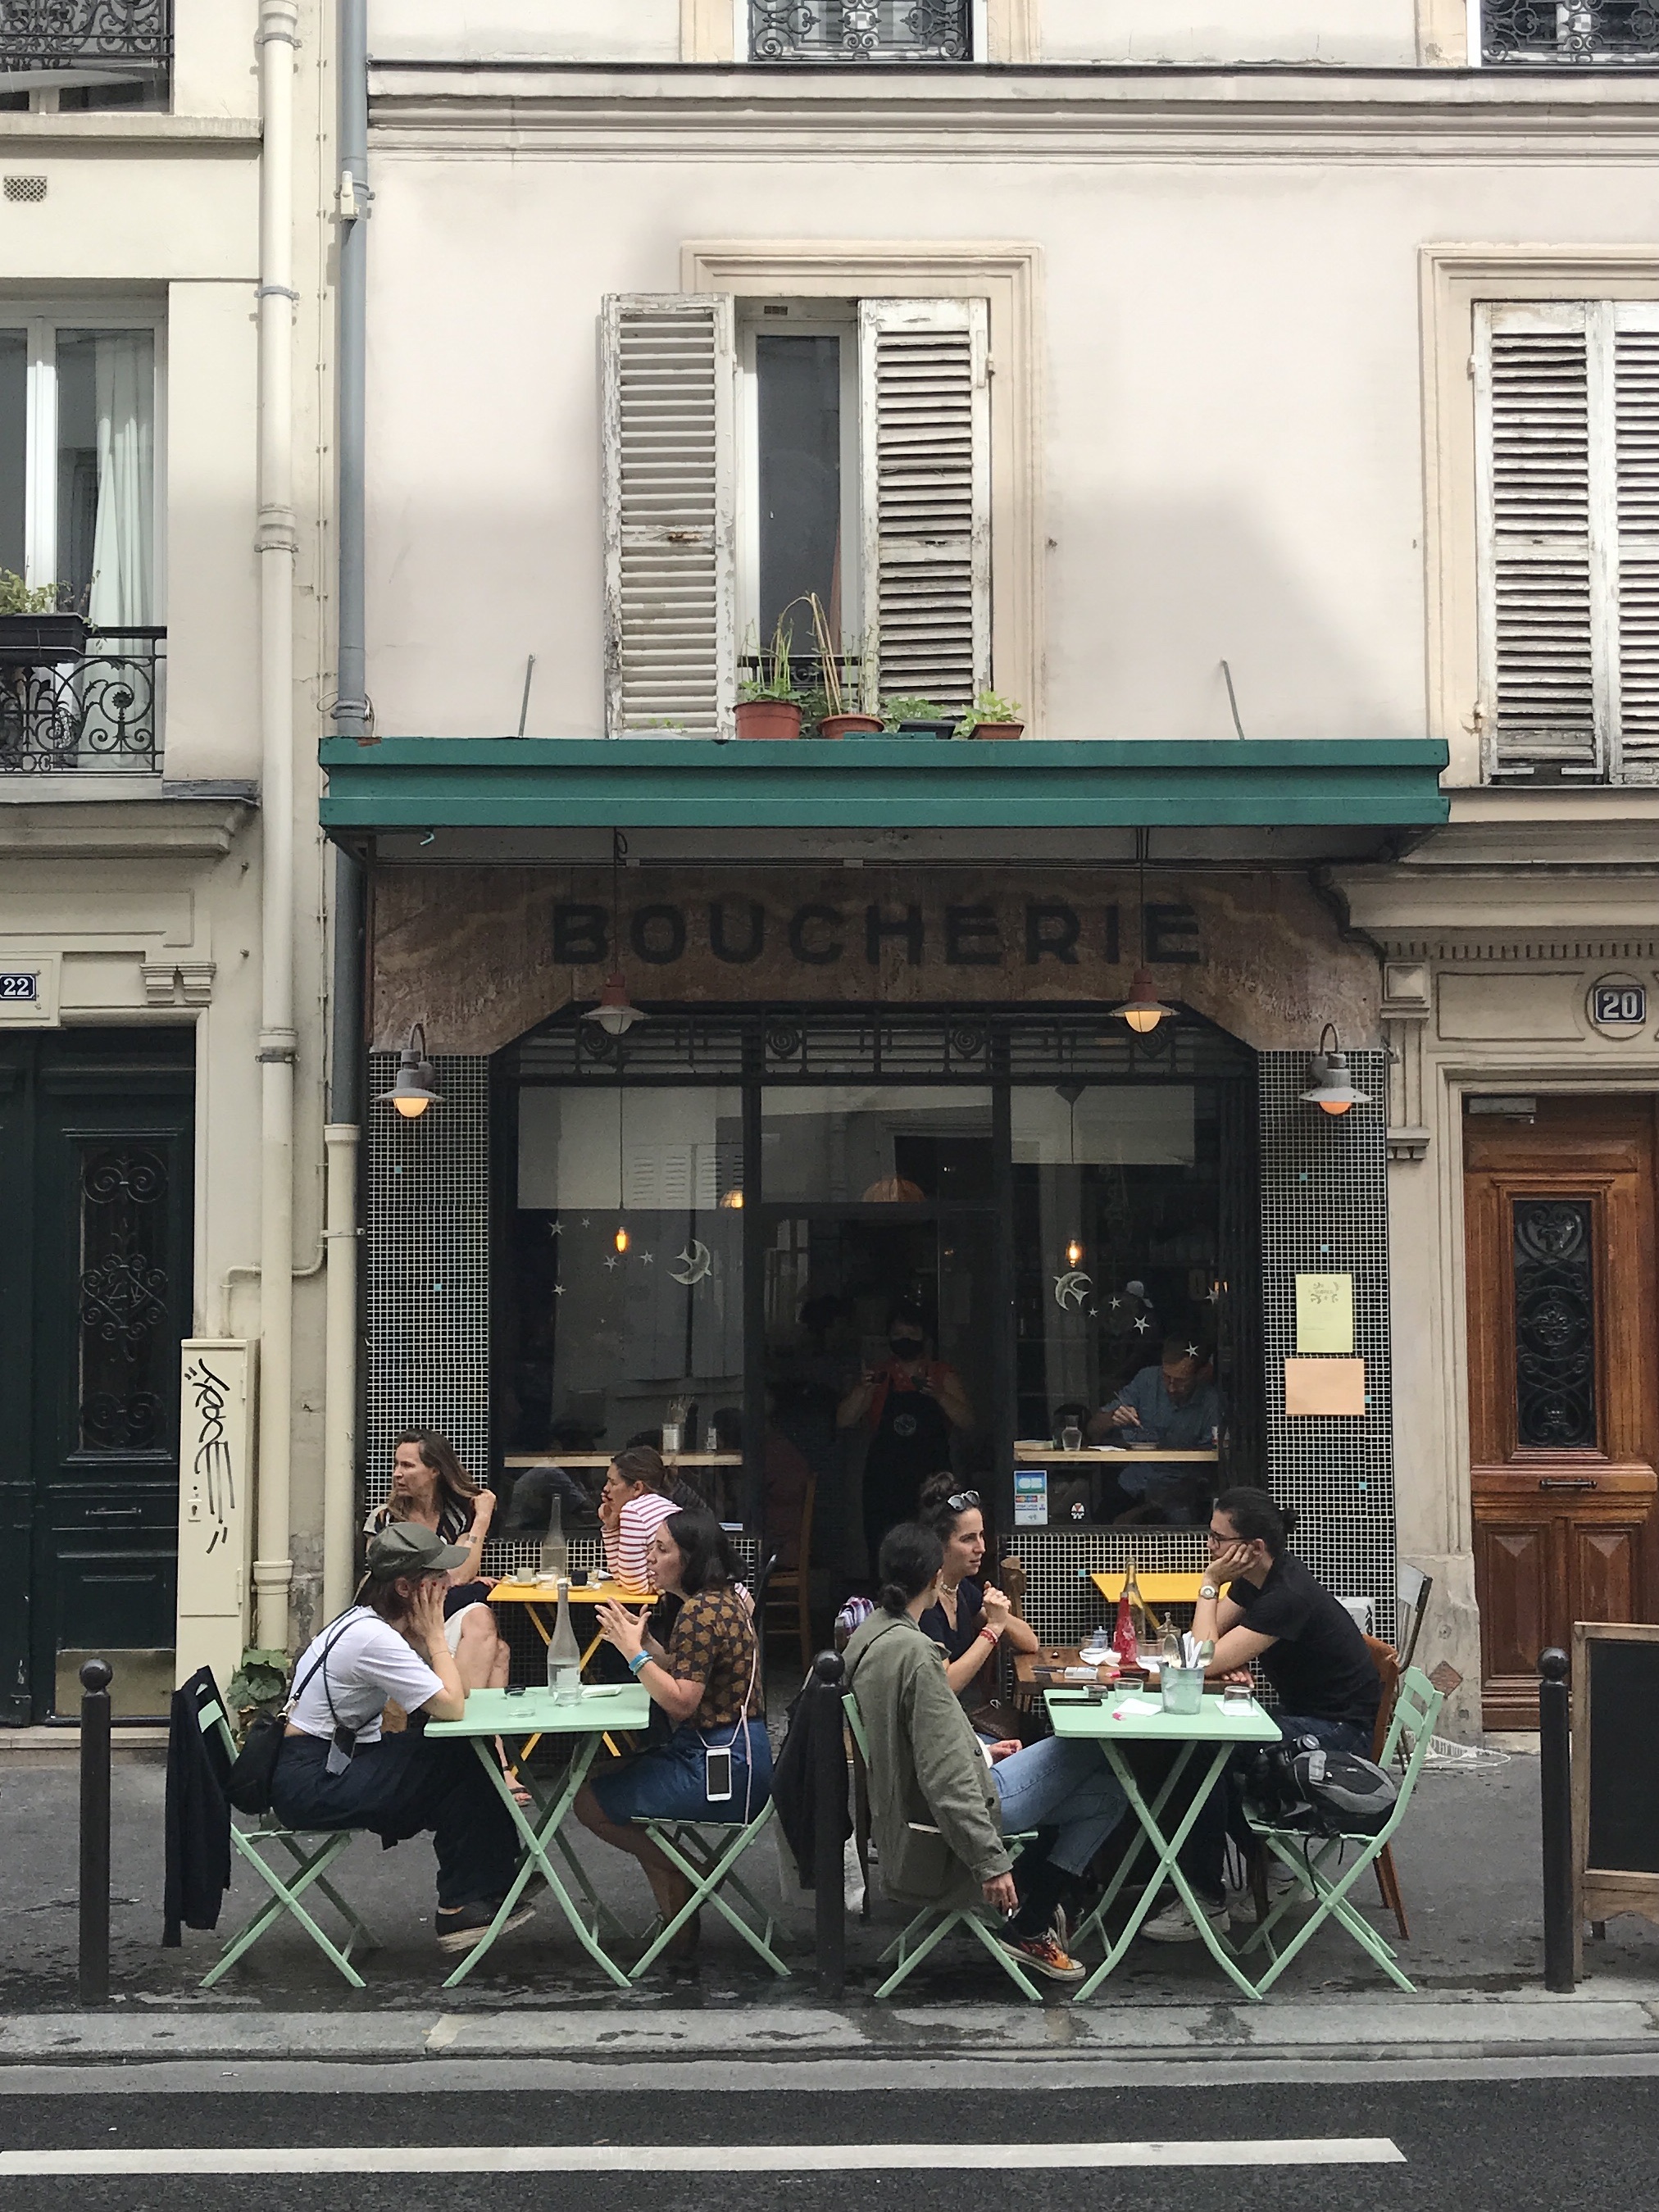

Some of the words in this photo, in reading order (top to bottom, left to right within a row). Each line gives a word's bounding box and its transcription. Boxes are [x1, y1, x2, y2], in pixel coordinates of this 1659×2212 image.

[552, 903, 1200, 965] BOUCHERIE
[4, 978, 29, 995] 22
[1603, 992, 1637, 1018] 20
